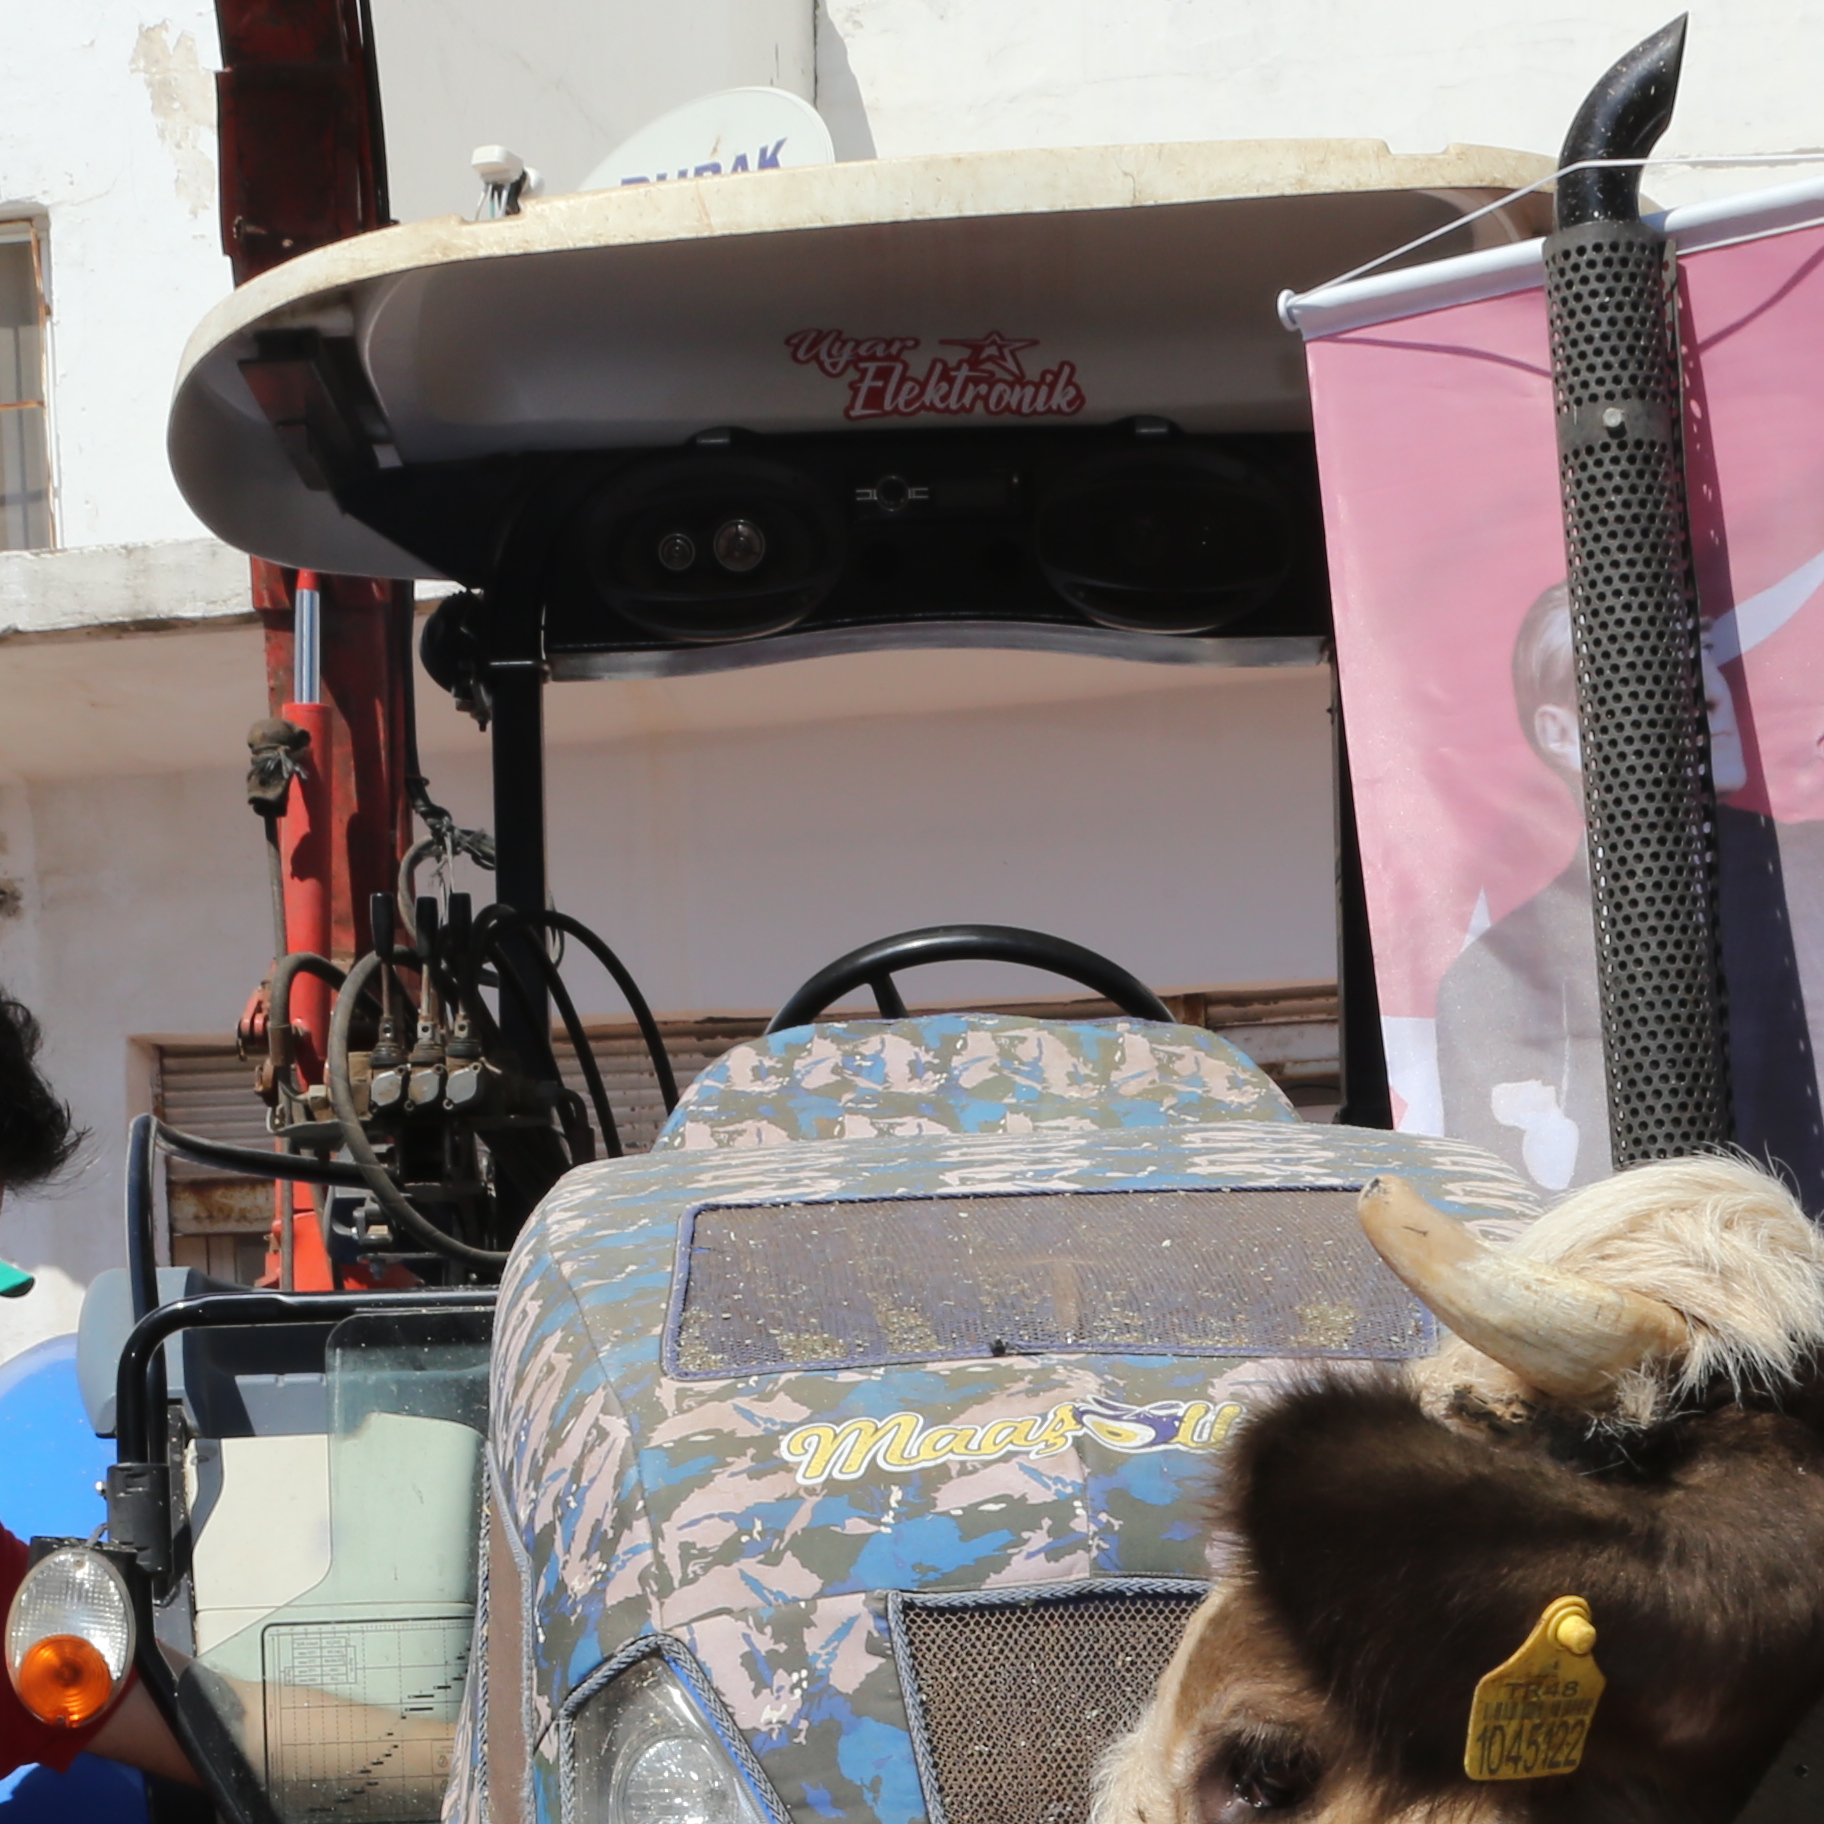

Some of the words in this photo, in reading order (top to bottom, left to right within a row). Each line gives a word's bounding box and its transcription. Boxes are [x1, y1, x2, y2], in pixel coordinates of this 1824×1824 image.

[785, 329, 919, 377] Uyar
[846, 358, 1082, 418] Elektronik
[1504, 1680, 1580, 1701] TR48
